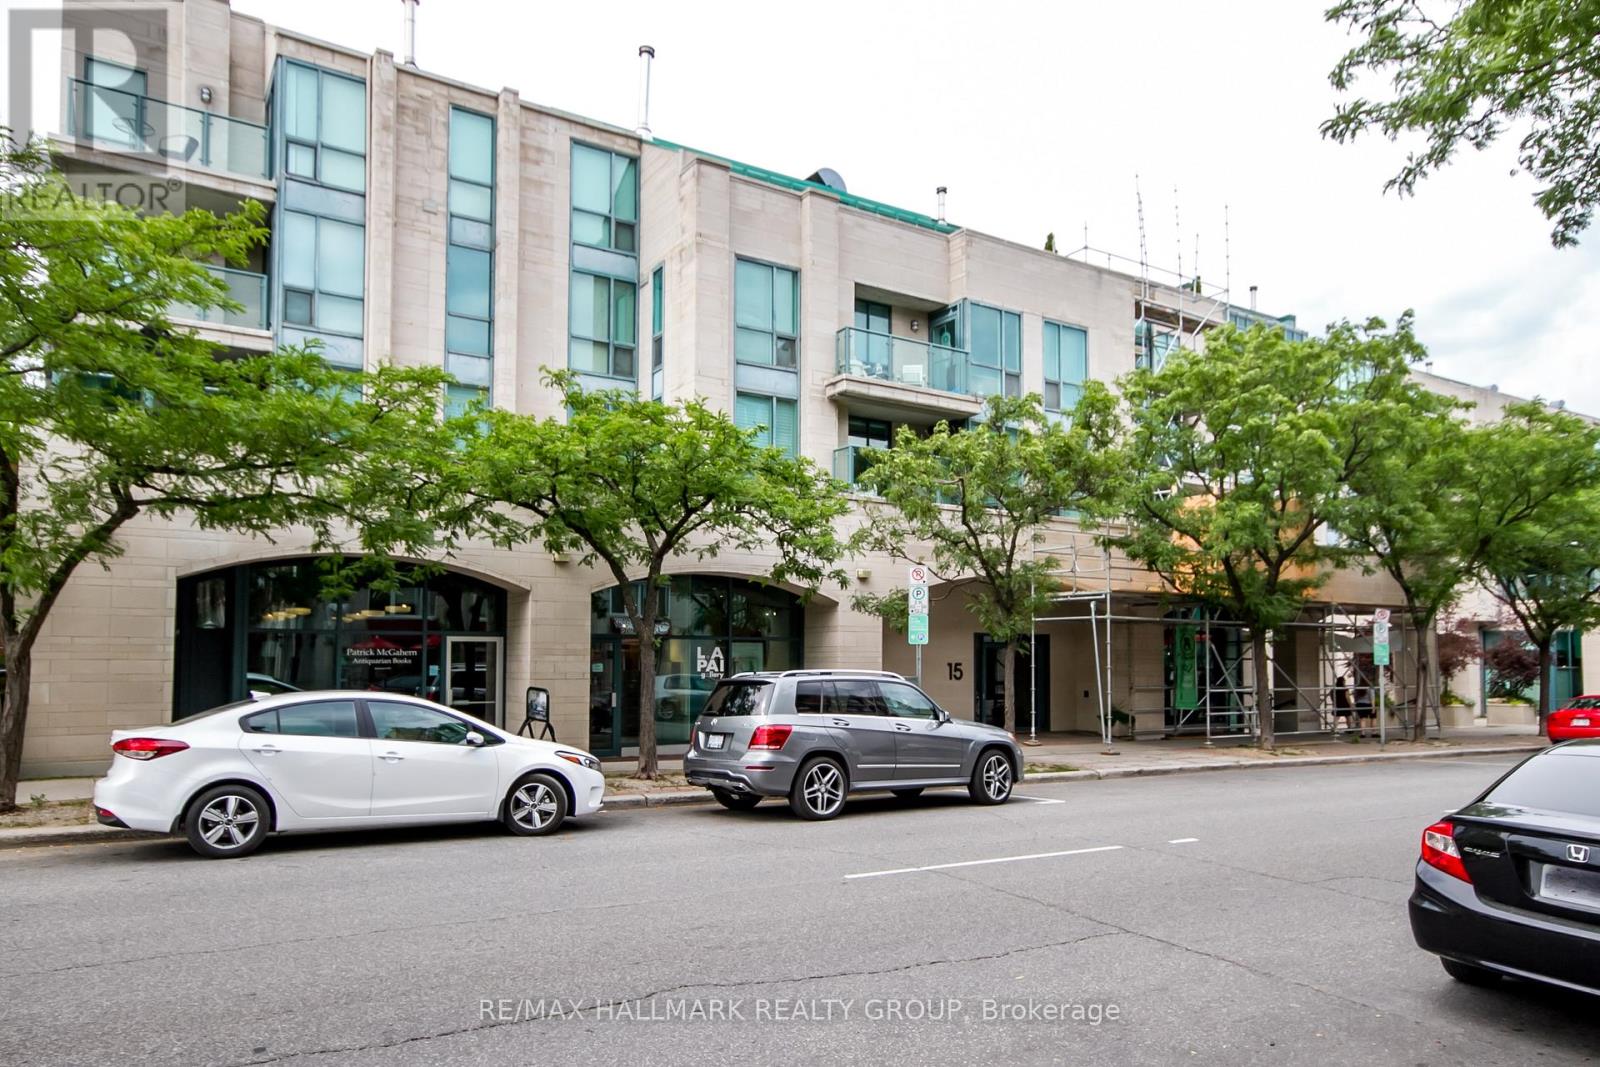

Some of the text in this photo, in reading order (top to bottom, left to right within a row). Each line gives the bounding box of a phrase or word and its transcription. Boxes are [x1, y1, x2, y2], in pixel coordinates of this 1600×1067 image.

[346, 648, 375, 656] Patrick
[352, 657, 412, 665] Antiquarian Books
[697, 659, 725, 672] PAI
[947, 662, 964, 681] 15
